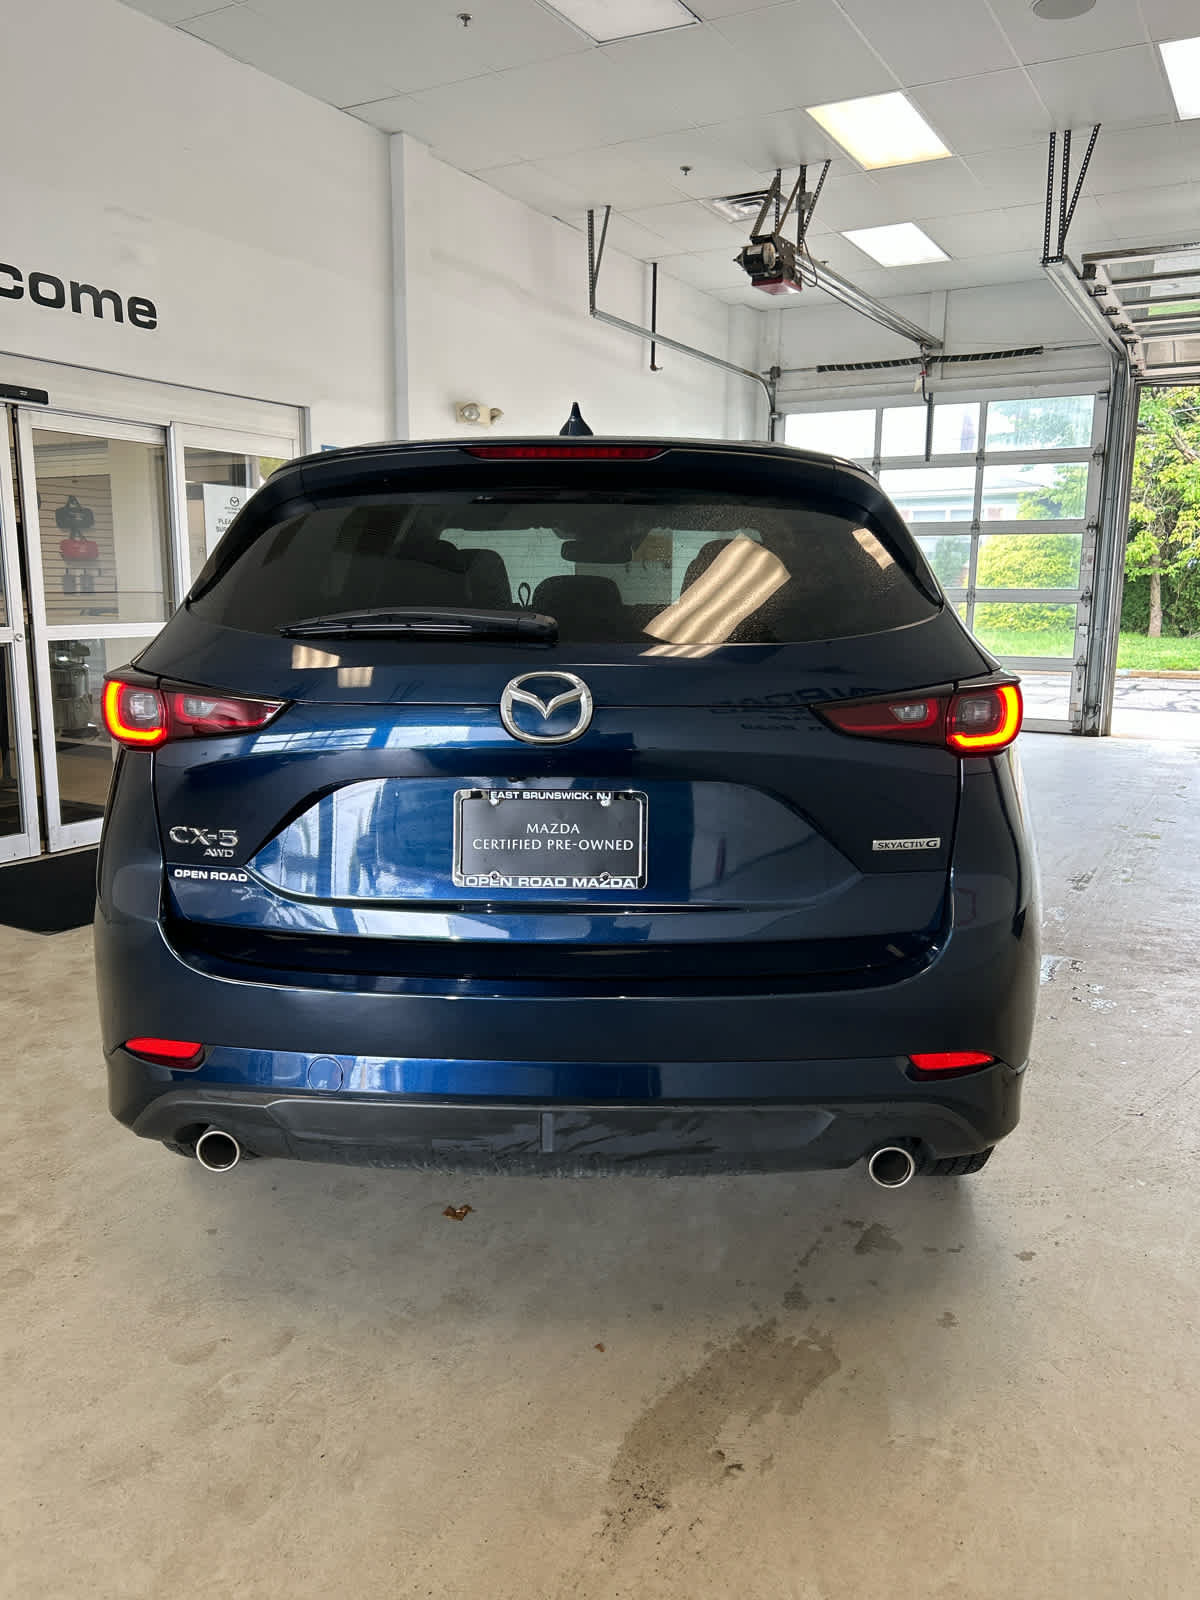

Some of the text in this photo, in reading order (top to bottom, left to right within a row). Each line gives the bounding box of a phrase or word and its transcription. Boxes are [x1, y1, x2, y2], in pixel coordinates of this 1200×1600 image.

[490, 791, 612, 801] EAST BRUNSWICK, NJ
[526, 823, 580, 834] MAZDA
[169, 826, 238, 847] CX-5
[472, 839, 634, 851] CERTIFIED PRE-OWNED
[203, 848, 234, 858] AWD
[174, 869, 248, 882] OPEN ROAD
[465, 876, 636, 888] OPEN ROAD MAZDA
